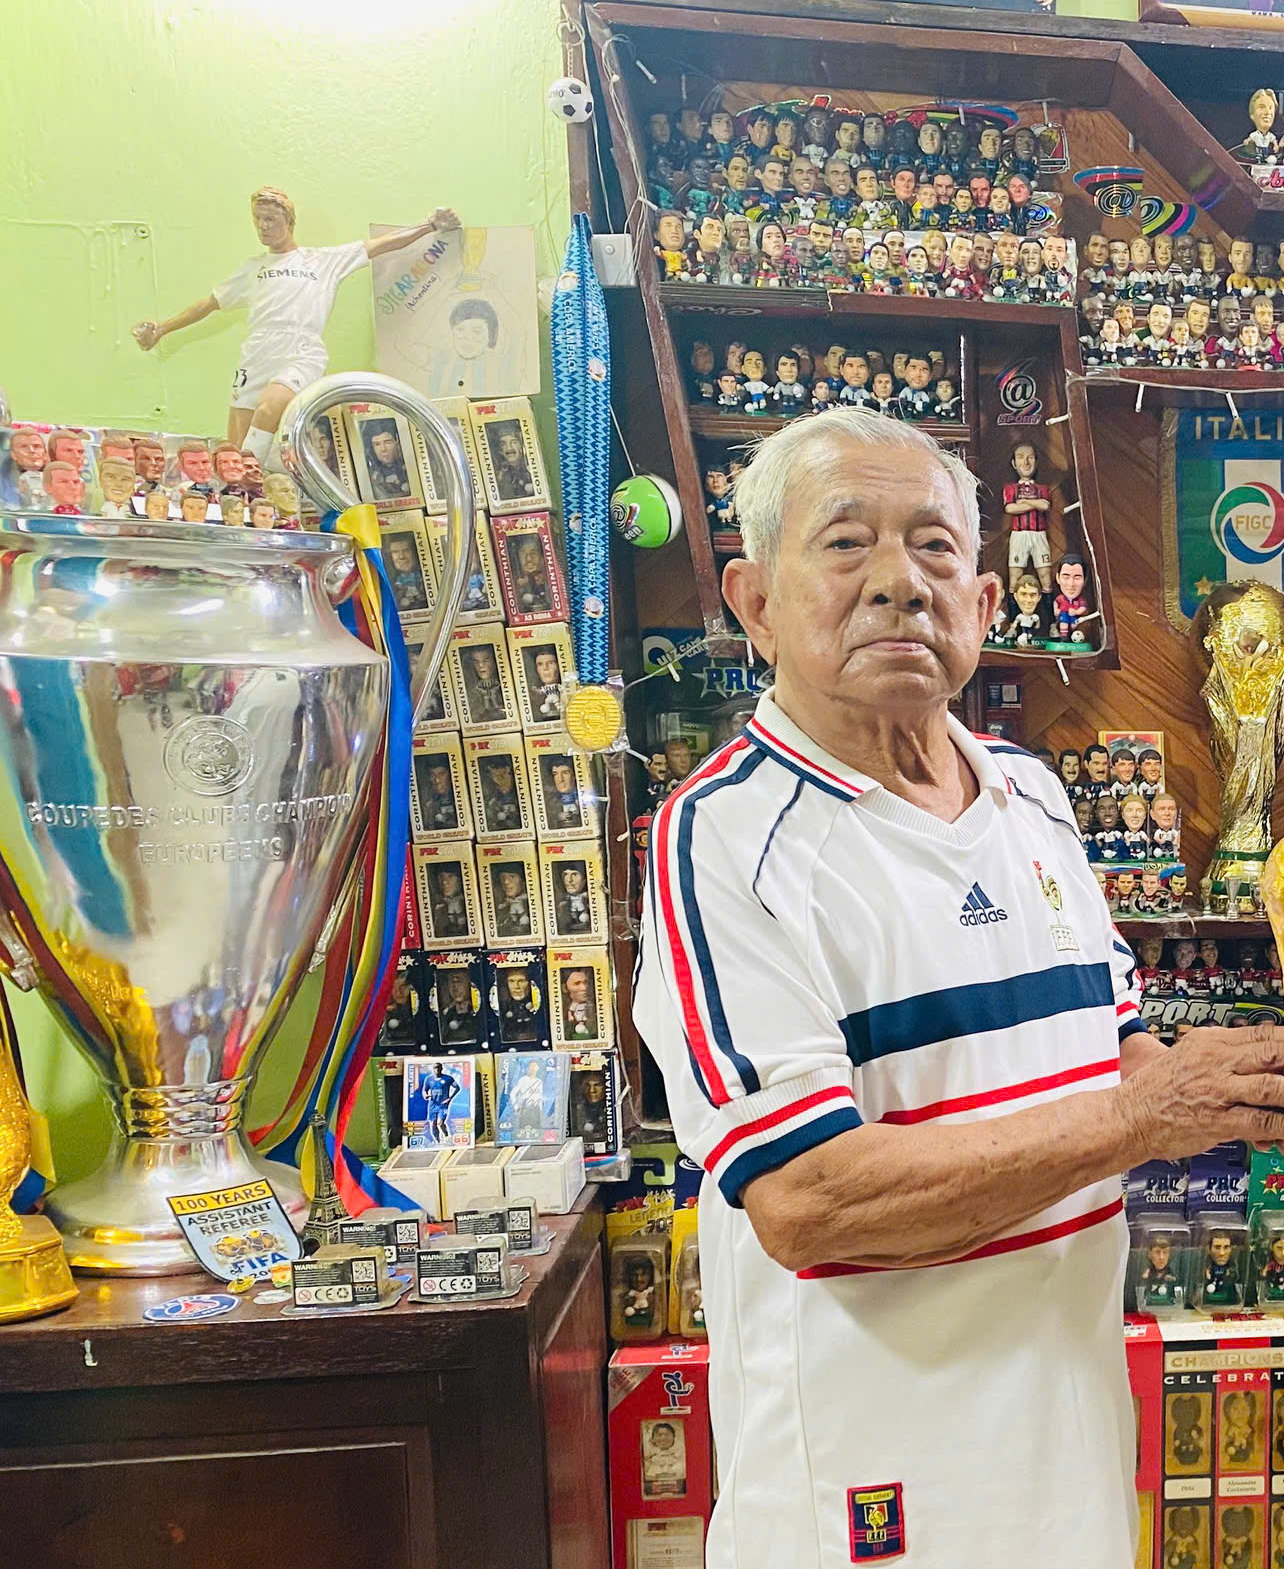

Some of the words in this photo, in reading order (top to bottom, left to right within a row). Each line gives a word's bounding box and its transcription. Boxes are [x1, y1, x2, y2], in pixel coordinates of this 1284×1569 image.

[257, 267, 317, 281] SIEMENS
[478, 425, 498, 501] CORINTHIAN
[522, 419, 543, 495] CORINTHIAN
[589, 518, 597, 560] AMERICA
[1235, 514, 1272, 530] FIGC
[416, 531, 434, 607] CORINTHIAN
[477, 532, 497, 607] CORINTHIAN
[498, 540, 517, 615] CORINTHIAN
[543, 534, 561, 609] CORINTHIAN
[588, 561, 596, 588] COPA
[1041, 554, 1050, 563] 13
[451, 649, 470, 723] CORINTHIAN
[495, 644, 513, 718] CORINTHIAN
[515, 649, 531, 723] CORINTHIAN
[451, 754, 465, 827] CORINTHIAN
[470, 760, 486, 832] CORINTHIAN
[514, 756, 530, 828] CORINTHIAN
[531, 758, 546, 830] CORINTHIAN
[419, 866, 432, 938] CORINTHIAN
[463, 862, 475, 935] CORINTHIAN
[482, 866, 495, 938] CORINTHIAN
[526, 862, 538, 935] CORINTHIAN
[544, 864, 556, 936] CORINTHIAN
[587, 861, 599, 933] CORINTHIAN
[960, 908, 1008, 926] adidas
[552, 970, 562, 1041] CORINTHIAN
[597, 968, 605, 1038] CORINTHIAN
[605, 1071, 615, 1143] CORINTHIAN
[176, 1198, 208, 1211] 100
[210, 1184, 267, 1207] YEARS
[188, 1201, 272, 1226] ASSISTANT
[200, 1213, 272, 1236] REFEREE
[233, 1252, 288, 1271] FIFA
[314, 1288, 333, 1301] CE
[439, 1278, 458, 1291] CE
[1171, 1351, 1283, 1368] CHAMPIONS
